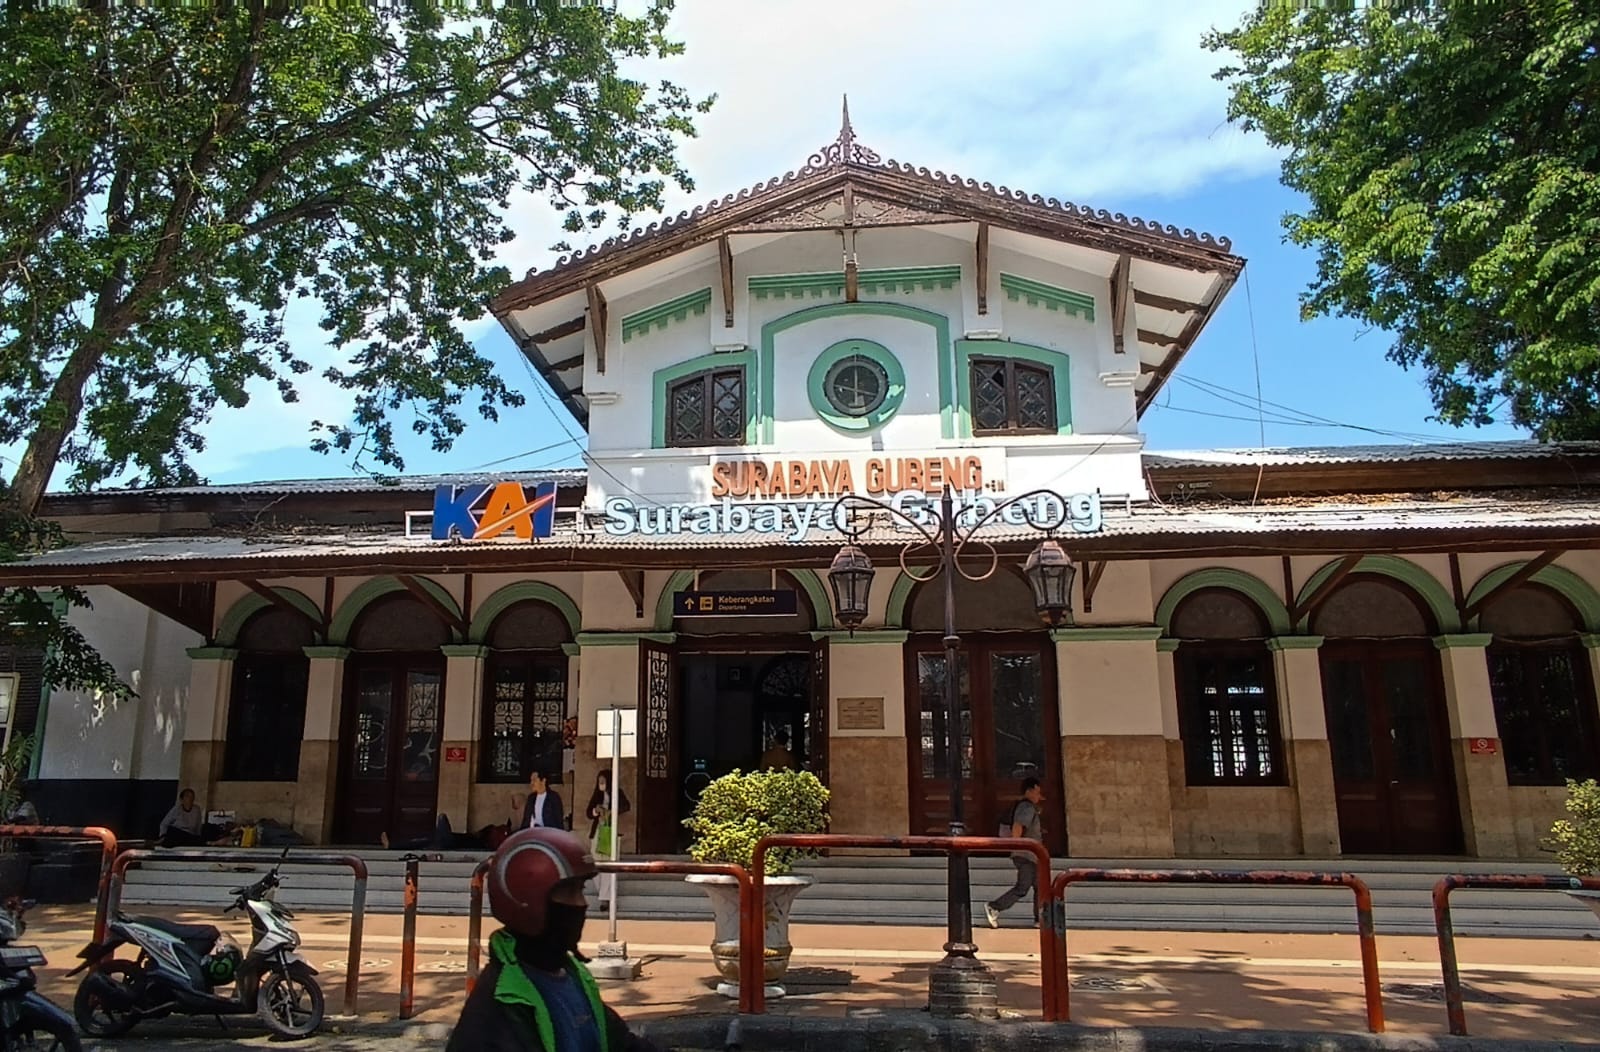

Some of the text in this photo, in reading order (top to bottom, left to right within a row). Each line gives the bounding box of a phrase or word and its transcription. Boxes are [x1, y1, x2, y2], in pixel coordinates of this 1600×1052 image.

[712, 456, 982, 498] SURABAYA GUBENG
[431, 481, 558, 540] KAI
[604, 496, 849, 543] Surabaya
